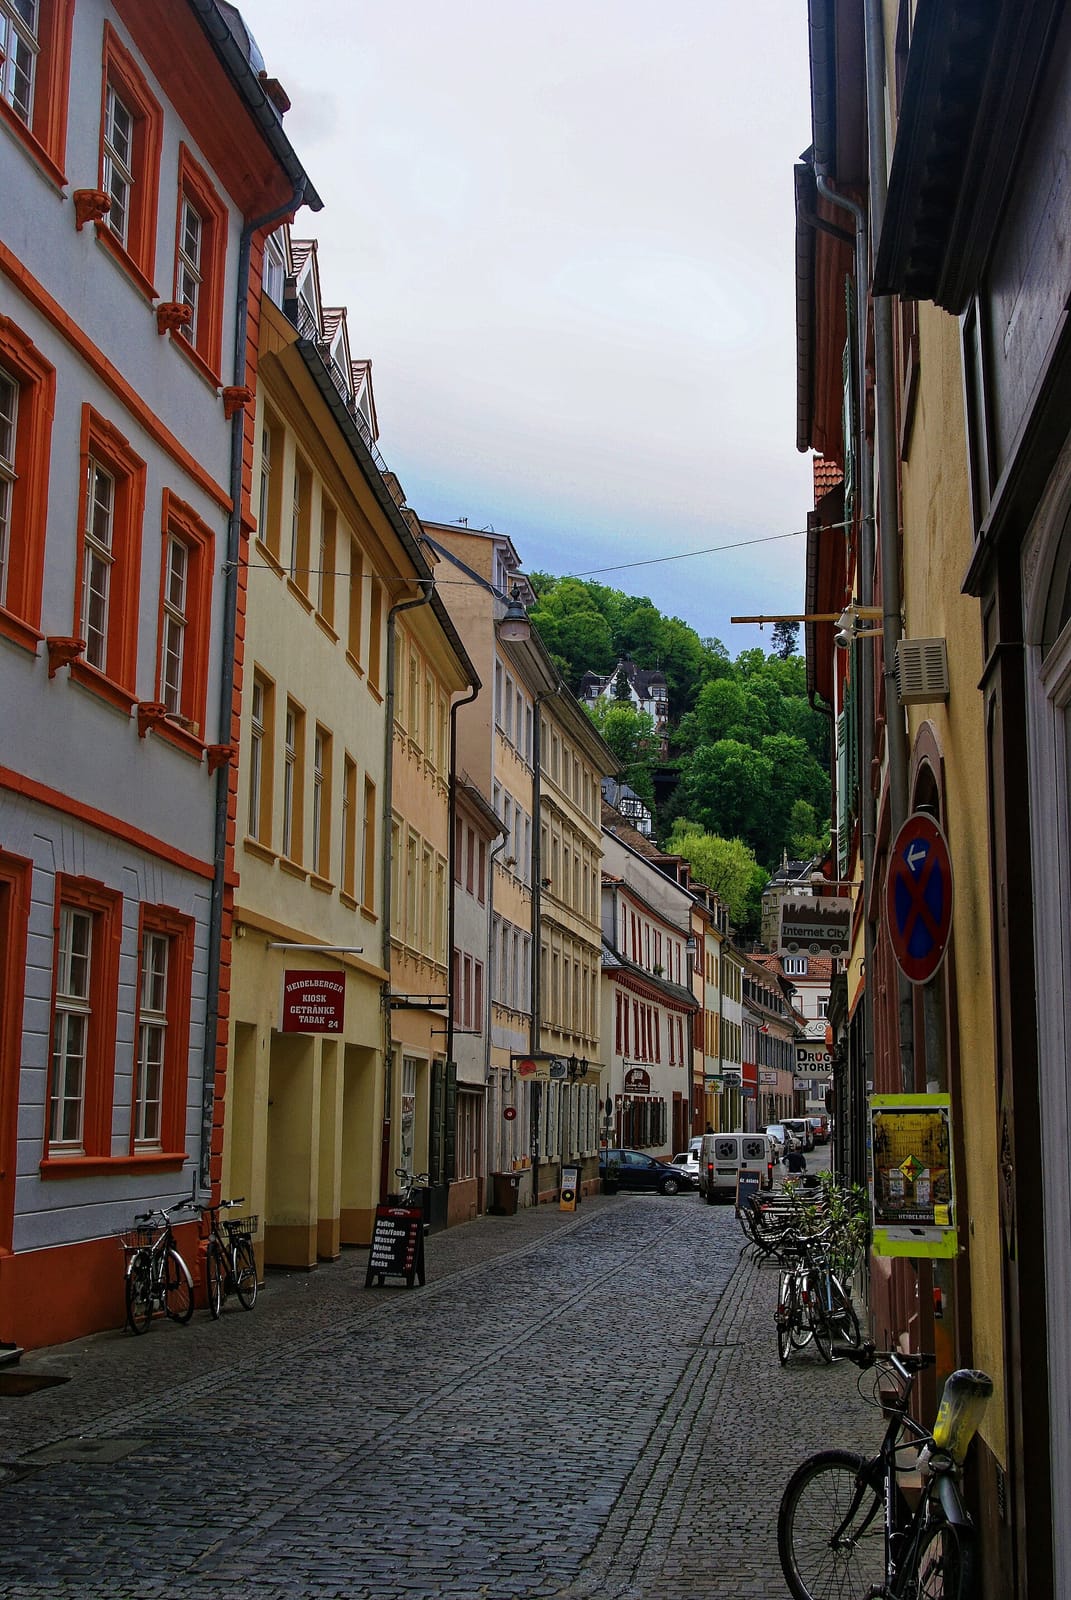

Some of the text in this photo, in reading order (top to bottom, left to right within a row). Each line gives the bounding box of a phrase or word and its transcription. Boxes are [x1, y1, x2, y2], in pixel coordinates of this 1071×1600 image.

[783, 926, 849, 939] Internet City
[286, 979, 344, 993] HEIDELBERGER
[302, 994, 327, 1003] KIOSK
[290, 1004, 335, 1015] GETRÄNKE
[299, 1015, 339, 1028] TABAK 24
[797, 1049, 830, 1062] DRUG
[797, 1063, 831, 1072] STORE
[374, 1236, 396, 1244] Wasser
